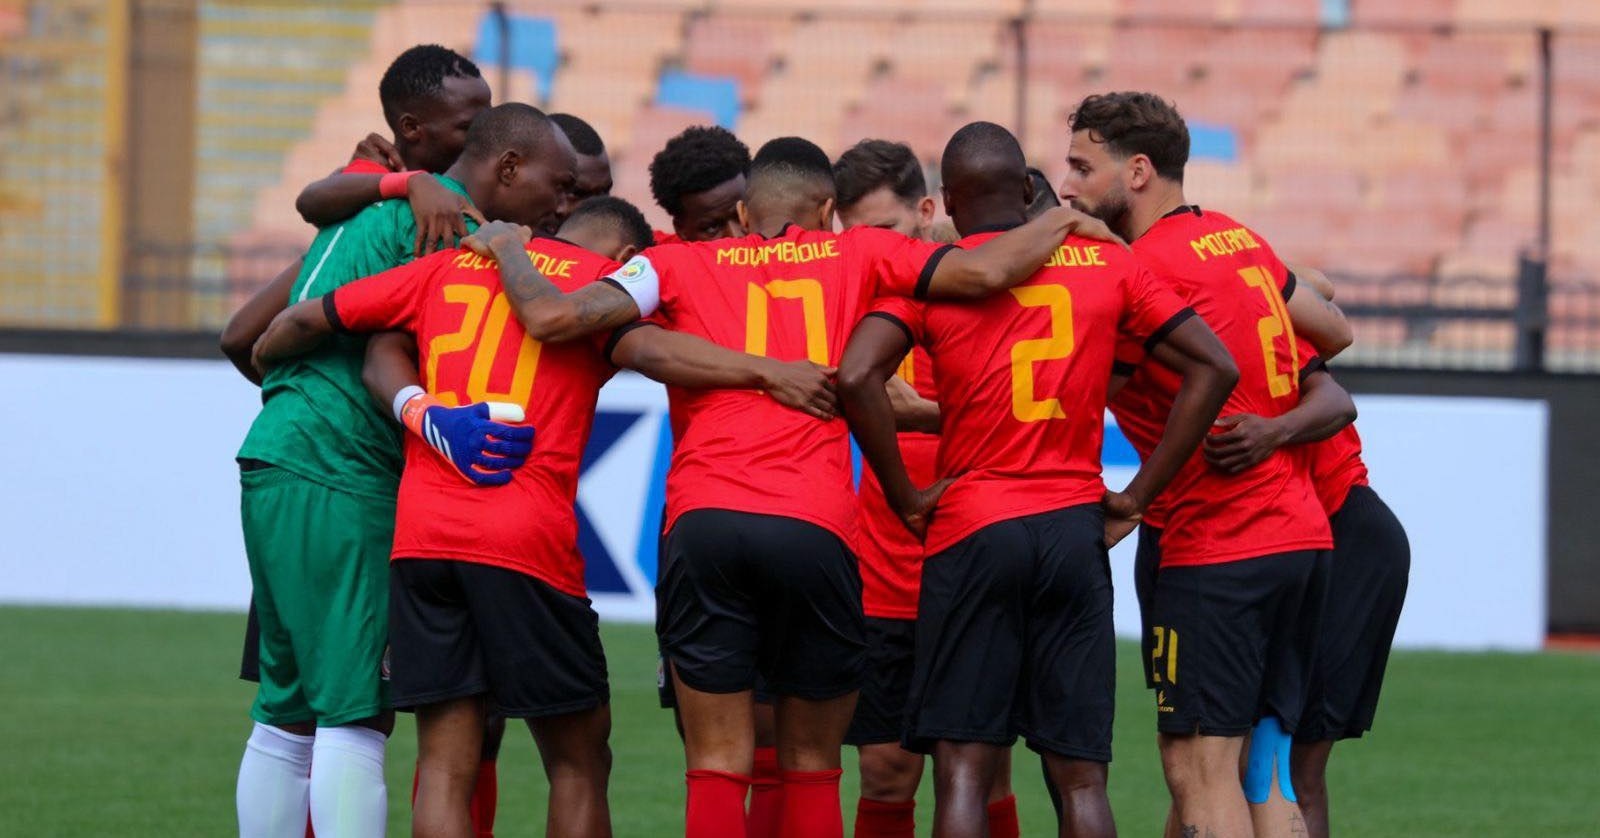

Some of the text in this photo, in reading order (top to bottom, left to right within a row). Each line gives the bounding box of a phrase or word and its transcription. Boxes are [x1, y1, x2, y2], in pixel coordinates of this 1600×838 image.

[426, 284, 542, 411] 20
[744, 278, 829, 367] 17
[1008, 283, 1074, 422] 2
[1237, 265, 1299, 398] 21
[1152, 625, 1179, 685] 21
